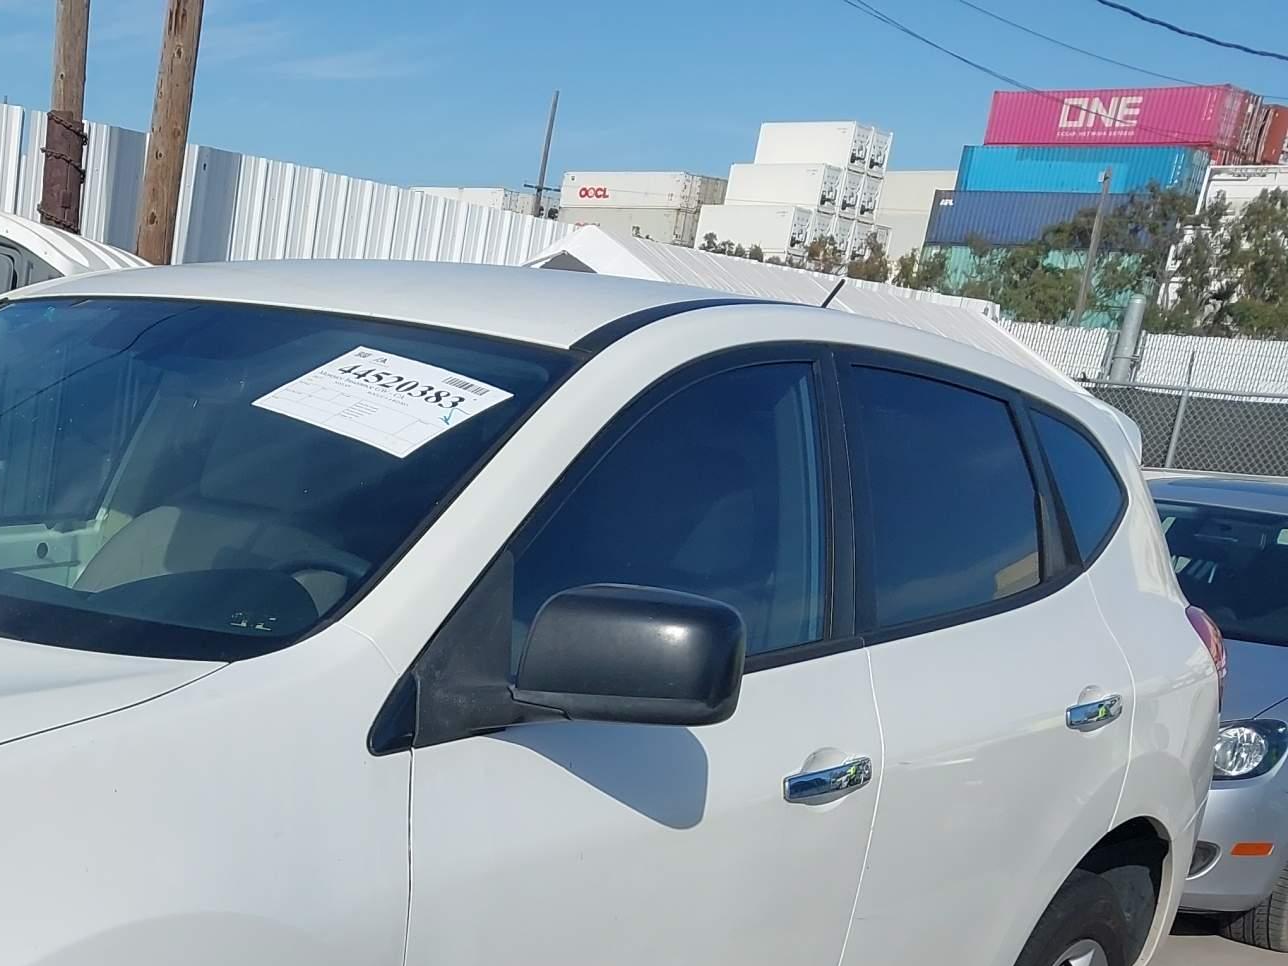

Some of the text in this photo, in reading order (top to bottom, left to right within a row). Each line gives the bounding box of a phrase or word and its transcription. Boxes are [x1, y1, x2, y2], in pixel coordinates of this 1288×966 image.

[1058, 96, 1143, 128] ONE
[579, 187, 609, 198] OOCL
[338, 365, 465, 408] 44520383
